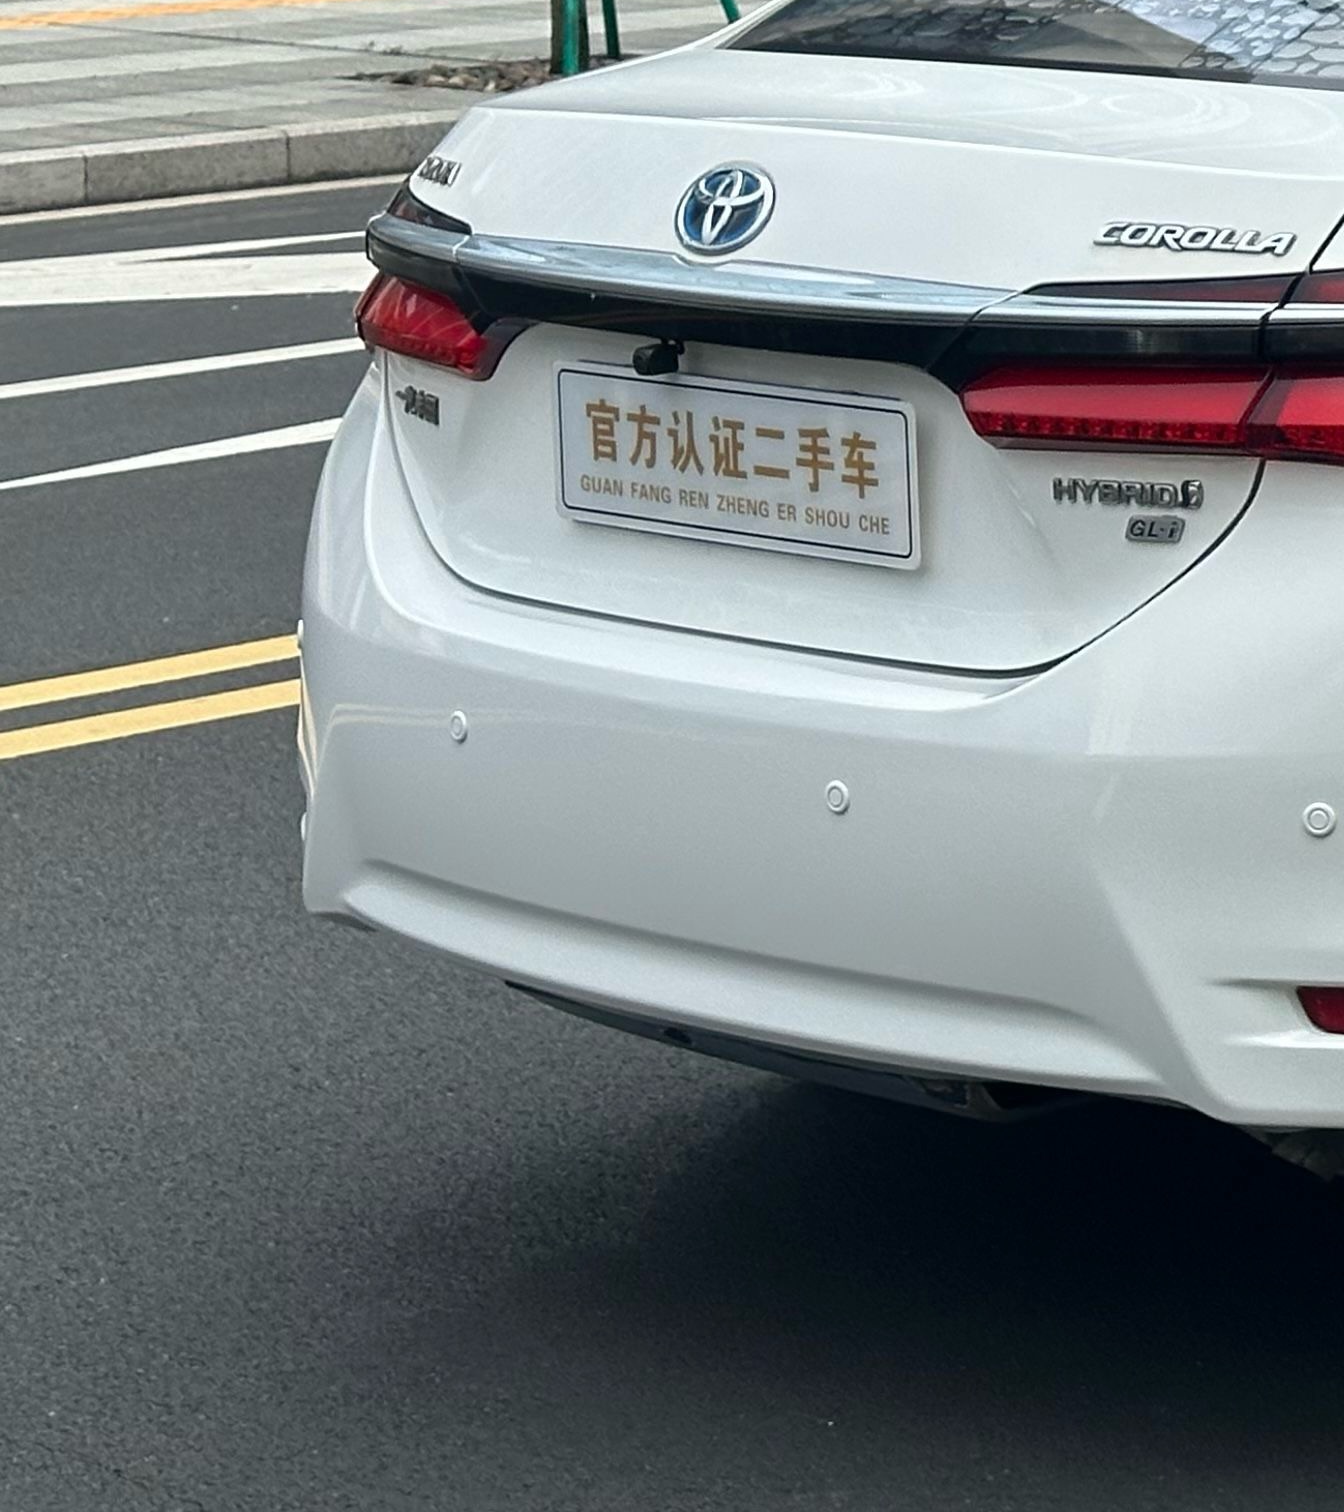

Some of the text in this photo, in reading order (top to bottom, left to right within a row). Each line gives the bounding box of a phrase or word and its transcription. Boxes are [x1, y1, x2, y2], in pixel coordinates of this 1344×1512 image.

[1093, 220, 1299, 257] COROLLA
[584, 398, 880, 499] 官方认证二手车
[580, 474, 891, 536] GUAN FANG REN ZHENG ER SHOU CHE
[1052, 477, 1178, 508] HYBRID
